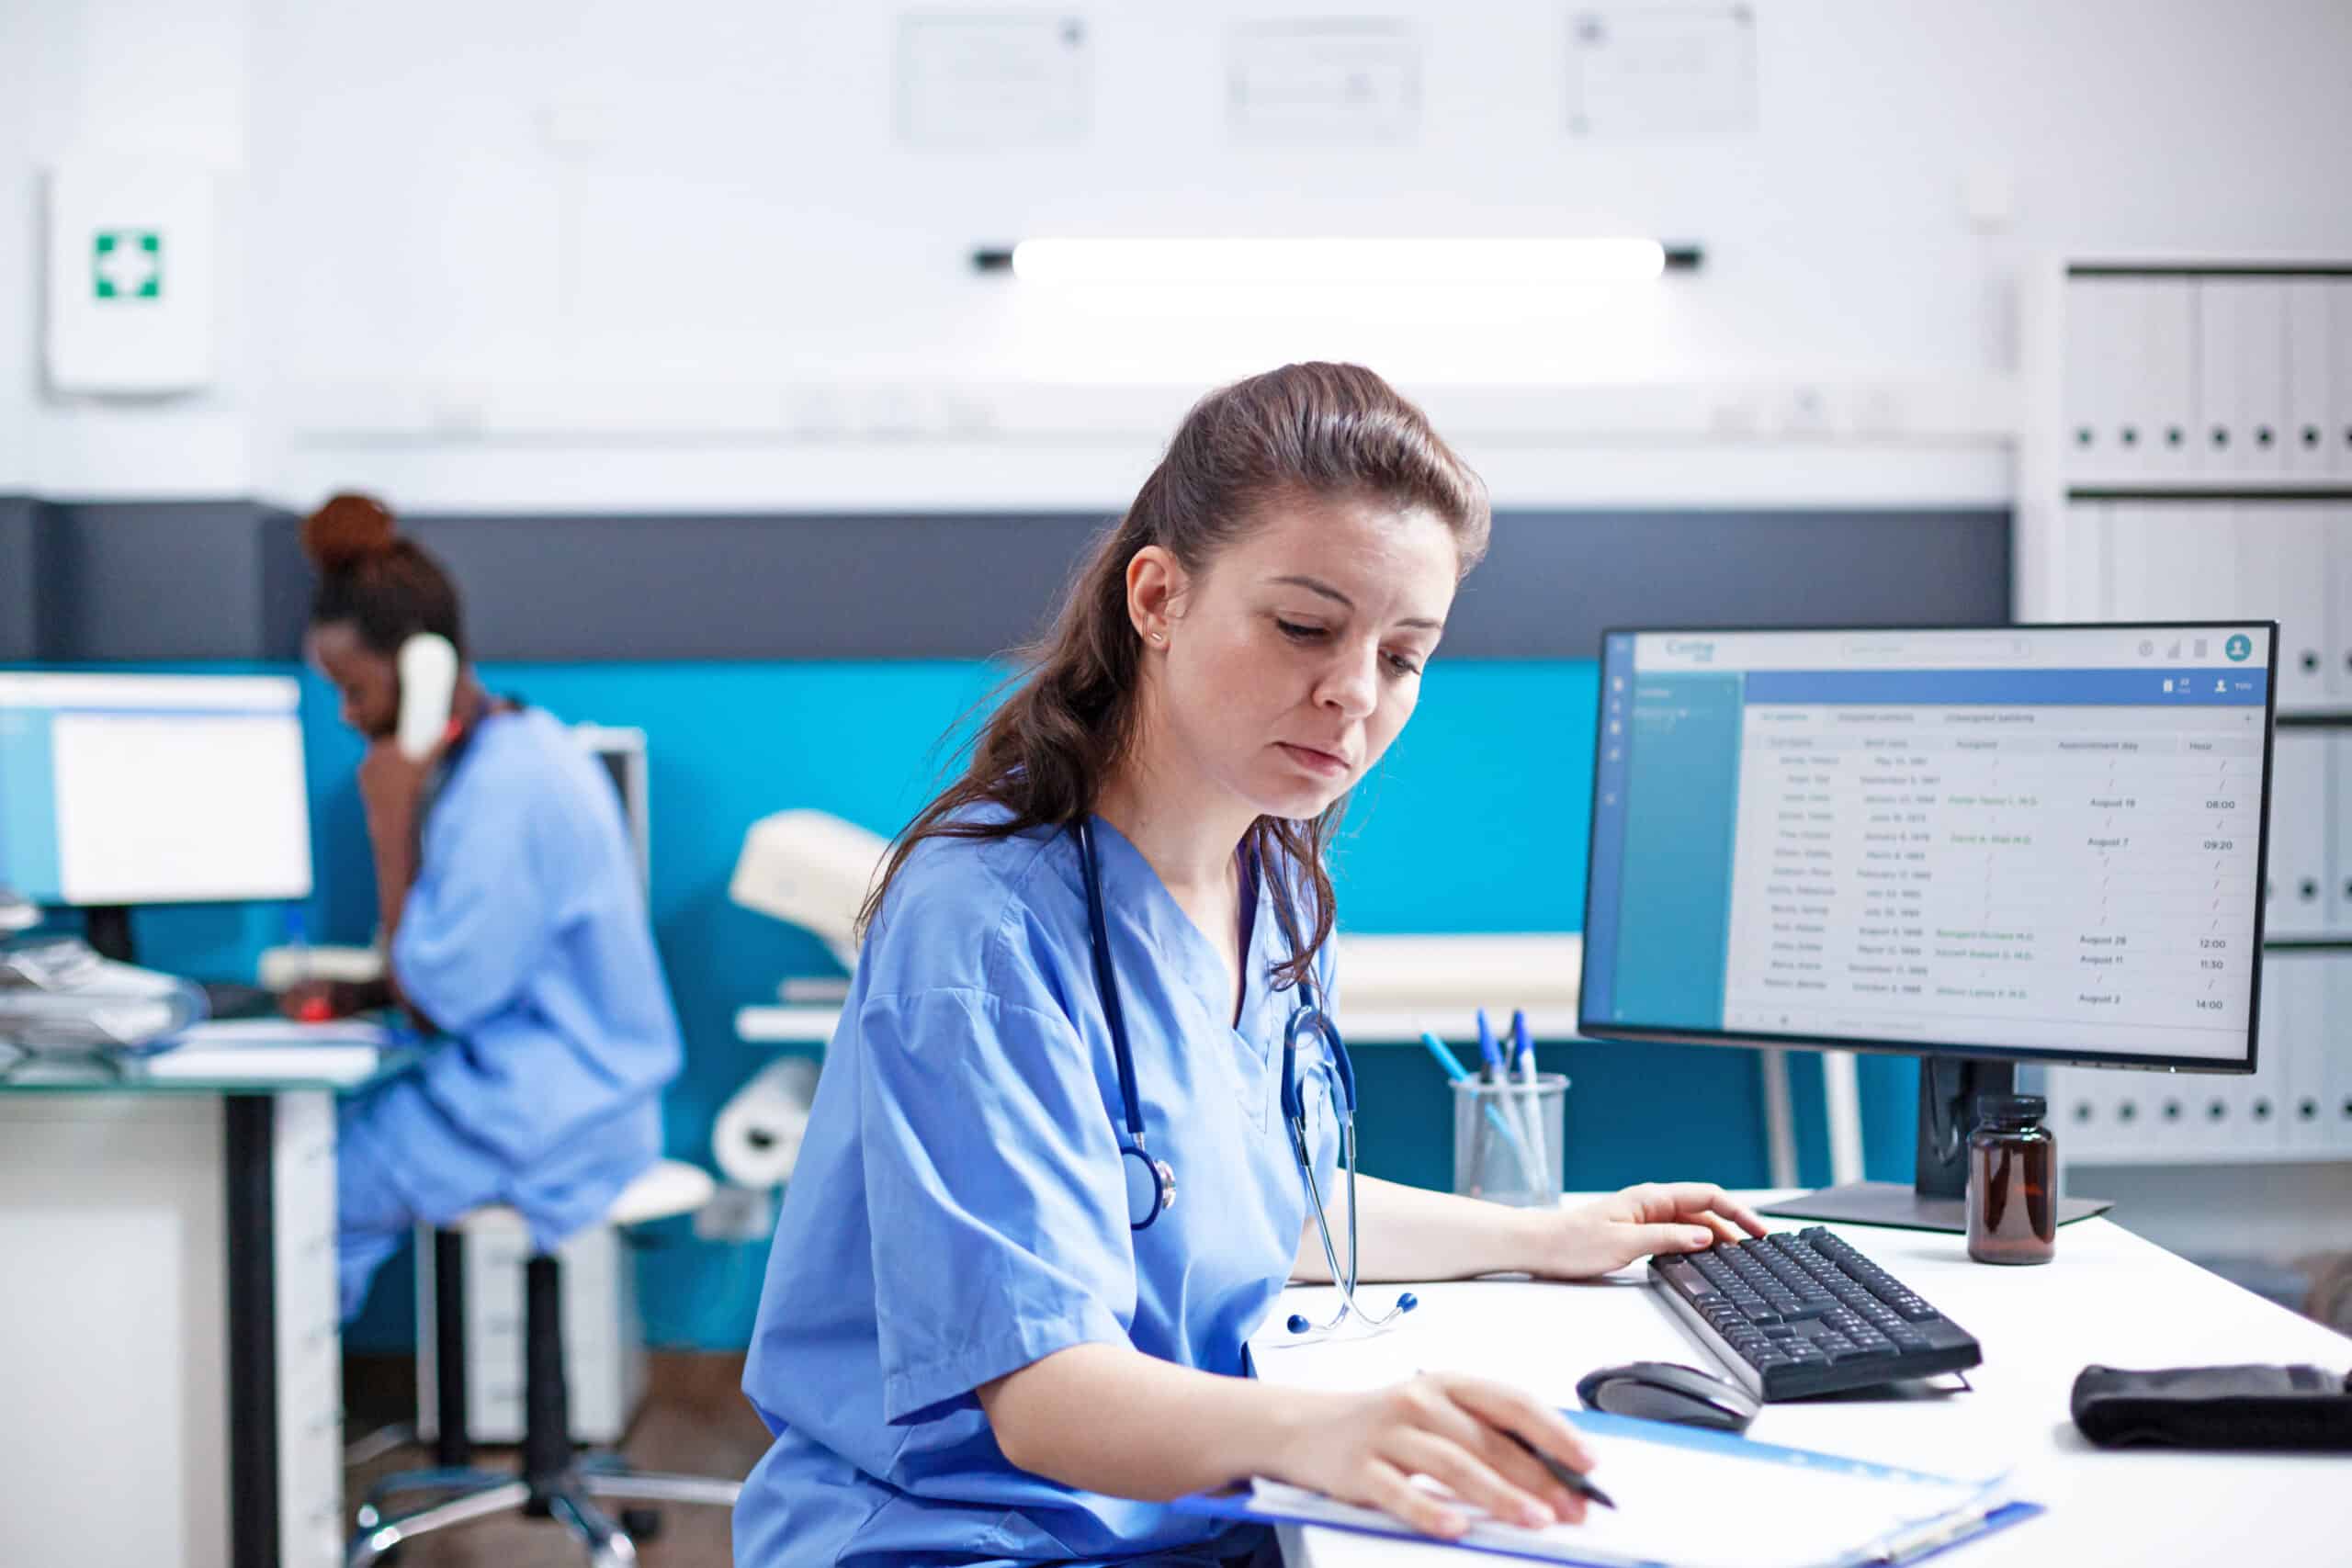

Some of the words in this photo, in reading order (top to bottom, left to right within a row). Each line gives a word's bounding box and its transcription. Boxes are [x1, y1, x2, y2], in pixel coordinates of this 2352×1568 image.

[2058, 740, 2119, 752] Appointment
[2121, 740, 2139, 753] day
[2189, 740, 2212, 750] Hour
[2089, 797, 2122, 809] August
[2206, 800, 2235, 810] 08:00
[2087, 838, 2120, 850] August
[2204, 840, 2233, 850] 09:20
[2080, 934, 2112, 946] August
[2199, 940, 2226, 949] 12:00
[2080, 954, 2112, 965] August
[2115, 954, 2124, 964] 11
[2079, 994, 2111, 1005] August
[2196, 999, 2223, 1010] 14:00
